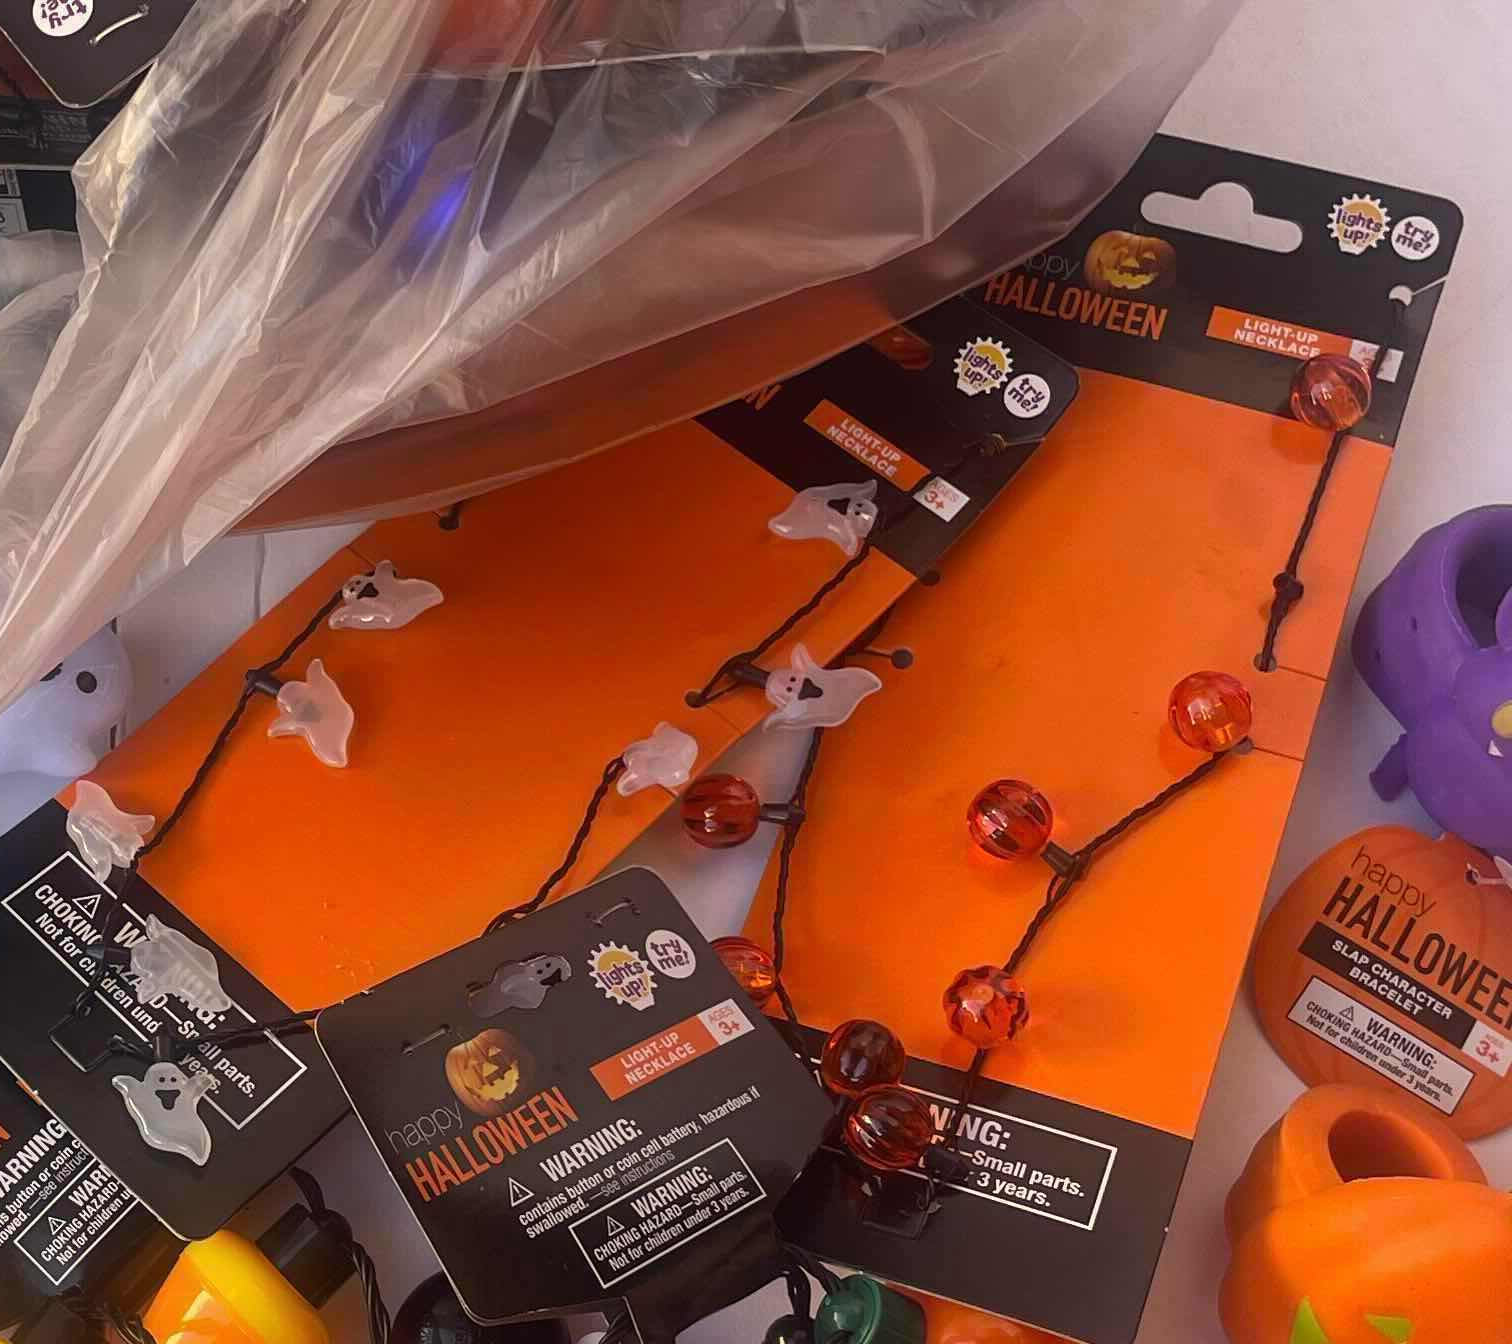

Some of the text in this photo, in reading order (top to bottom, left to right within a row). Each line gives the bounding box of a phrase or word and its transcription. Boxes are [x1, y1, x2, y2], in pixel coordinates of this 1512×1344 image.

[1334, 208, 1383, 235] lights
[1341, 227, 1371, 248] up!
[1395, 230, 1433, 255] me!
[1402, 217, 1436, 244] try
[988, 269, 1168, 340] HALLOWEEN
[1234, 329, 1322, 362] NECKLACE
[1244, 318, 1319, 344] LIGHT-UP
[962, 346, 1003, 383] lights
[963, 362, 991, 387] up!
[1007, 386, 1039, 413] me!
[1018, 377, 1046, 409] try
[827, 425, 897, 477] NECKLACE
[841, 417, 901, 464] LIGHT-UP
[921, 486, 948, 512] 3+
[1350, 845, 1436, 918] happy
[34, 912, 84, 960] Not for
[650, 937, 687, 962] try
[596, 958, 645, 993] lights
[656, 947, 690, 975] me!
[1331, 939, 1453, 1019] SLAP CHARACTER
[619, 975, 648, 1004] up!
[1348, 967, 1423, 1015] BRACELET
[716, 1016, 742, 1038] 3+
[1305, 1014, 1408, 1081] Not children under
[1366, 1017, 1437, 1070] WARNING:
[620, 1032, 679, 1069] LIGHT-UP
[624, 1042, 696, 1085] NECKLACE
[1306, 1000, 1456, 1098] CHOKING parts.
[214, 1057, 256, 1098] parts.
[384, 1101, 463, 1153] happy
[408, 1088, 576, 1200] HALLOWEEN
[518, 1092, 752, 1226] contains button coin cell hazardous
[540, 1119, 642, 1181] WARNING:
[5, 1180, 41, 1215] button
[49, 1146, 74, 1171] coin
[526, 1149, 676, 1239] swallowed. instructions
[631, 1166, 713, 1218] WARNING:
[994, 1178, 1051, 1207] years.
[1028, 1169, 1085, 1197] parts.
[40, 1216, 84, 1262] CHOKING
[55, 1197, 124, 1266] Not for children
[593, 1227, 642, 1261] CHOKING
[608, 1204, 714, 1272] Not children under
